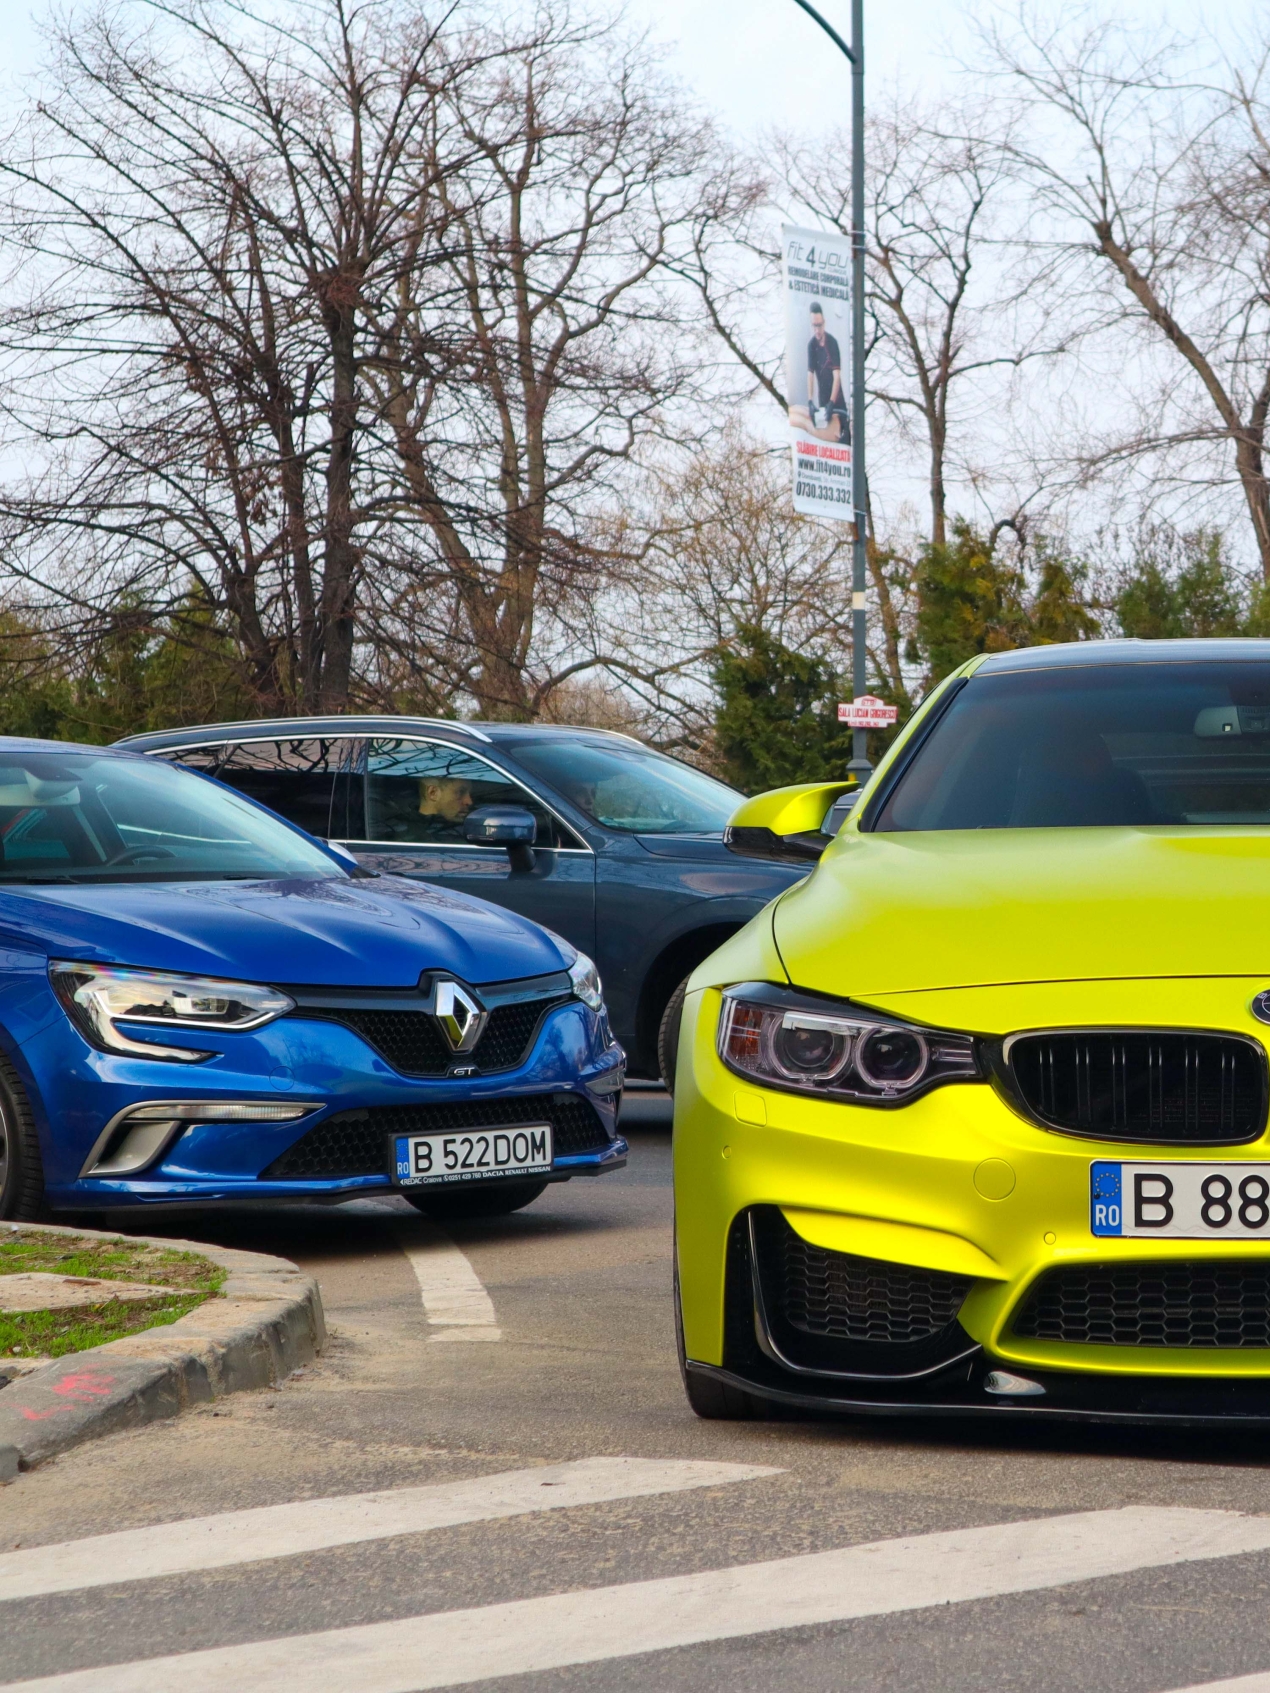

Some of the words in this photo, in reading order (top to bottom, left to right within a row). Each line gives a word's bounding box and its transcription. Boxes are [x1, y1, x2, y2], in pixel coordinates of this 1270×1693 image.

[787, 241, 804, 261] fit
[806, 245, 816, 268] 4
[818, 250, 849, 269] you
[798, 458, 851, 478] www.fit4you.ro
[796, 481, 851, 504] 0730.333.332
[852, 708, 868, 718] LUCIAN
[454, 1067, 476, 1076] GT
[397, 1162, 409, 1175] RO
[414, 1141, 433, 1173] B
[403, 1177, 422, 1185] REDAC
[423, 1176, 442, 1184] Craiova
[482, 1170, 504, 1178] DACIA
[505, 1168, 527, 1176] RENAULT
[528, 1166, 551, 1174] NISSAN
[1095, 1204, 1120, 1227] RO
[1134, 1173, 1174, 1228] B
